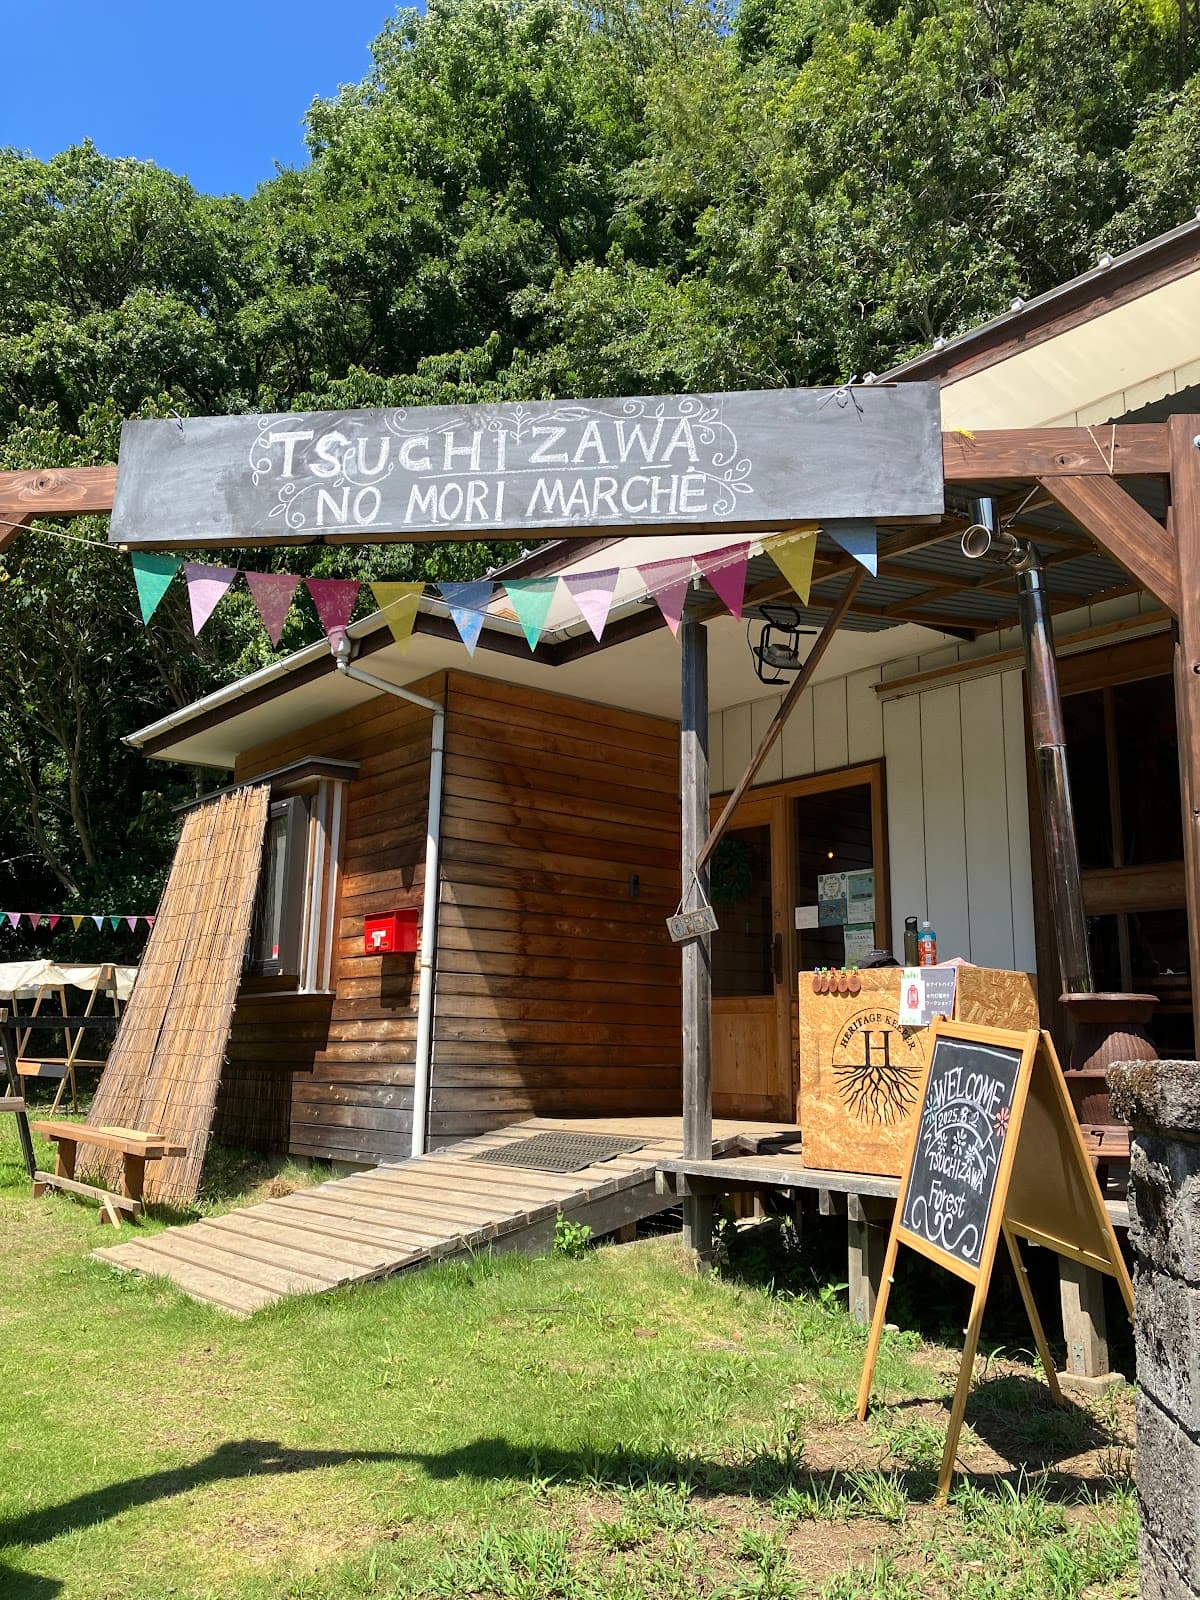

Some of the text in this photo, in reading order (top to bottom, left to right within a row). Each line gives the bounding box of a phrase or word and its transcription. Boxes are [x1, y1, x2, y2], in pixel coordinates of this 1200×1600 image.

[315, 485, 381, 525] NO
[403, 480, 505, 523] MORI
[840, 1013, 882, 1049] HERITAGE
[932, 1066, 1005, 1121] WELCOME
[928, 1151, 984, 1195] TSUCHIZAWA
[928, 1180, 966, 1218] Forest
